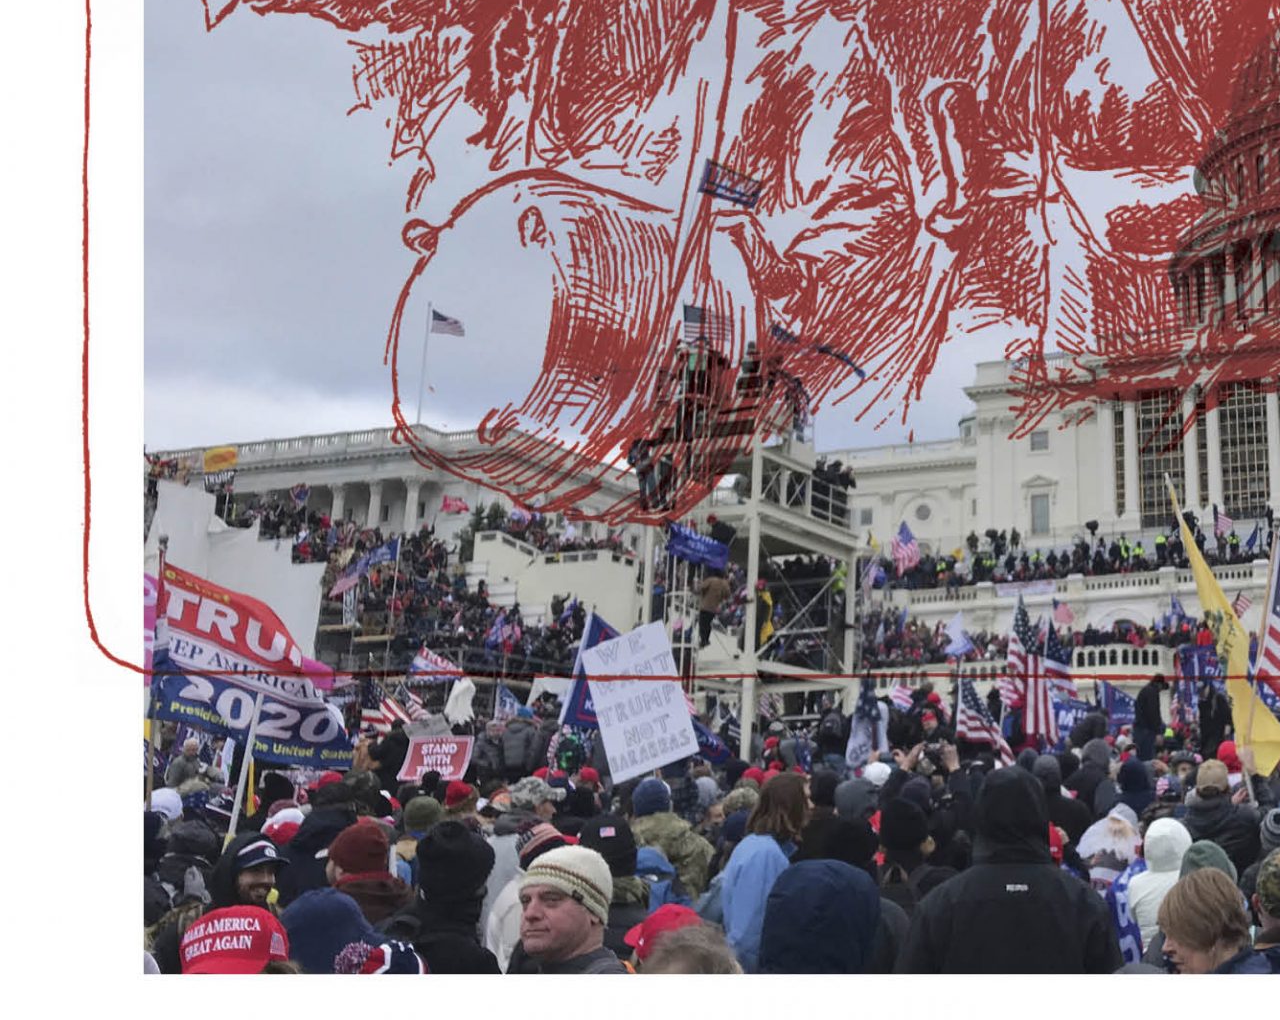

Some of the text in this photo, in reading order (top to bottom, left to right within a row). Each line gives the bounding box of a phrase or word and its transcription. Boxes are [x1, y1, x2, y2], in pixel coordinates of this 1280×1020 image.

[168, 635, 310, 698] EP AMERICA
[160, 676, 339, 743] 2020
[170, 701, 229, 727] Presiden
[601, 684, 675, 728] TRUMP
[623, 713, 670, 748] NOT
[421, 743, 457, 755] STAND
[423, 754, 451, 766] WITH
[205, 917, 261, 936] AMERICA
[184, 935, 252, 963] GREAT AGAIN
